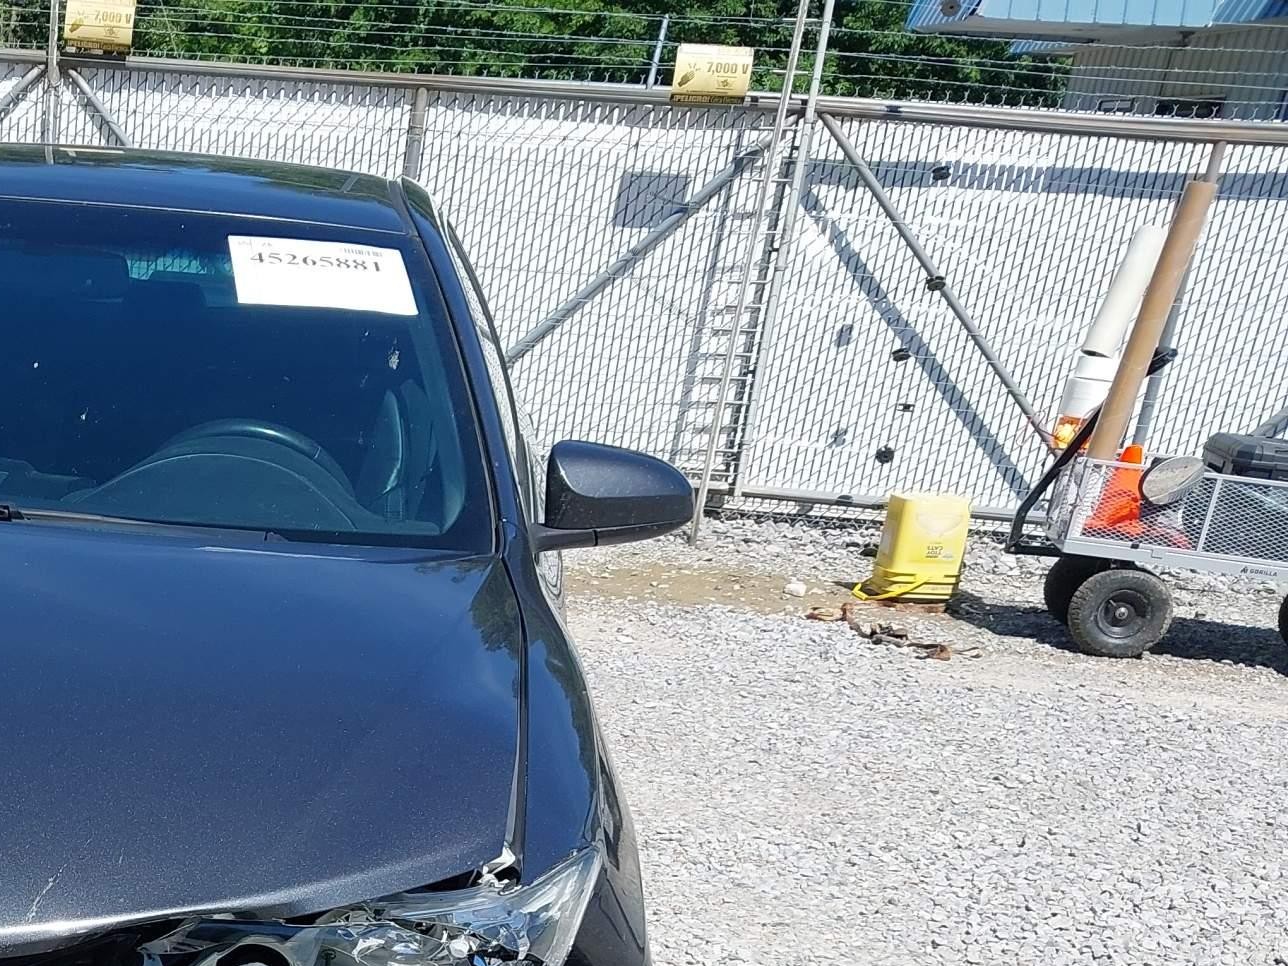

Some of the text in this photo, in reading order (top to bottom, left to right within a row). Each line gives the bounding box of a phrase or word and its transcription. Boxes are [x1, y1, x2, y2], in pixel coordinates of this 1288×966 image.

[94, 10, 132, 24] 7,000 V
[706, 62, 749, 75] 7,000 V
[250, 251, 381, 272] 45265881
[1250, 568, 1277, 577] GORILLA
